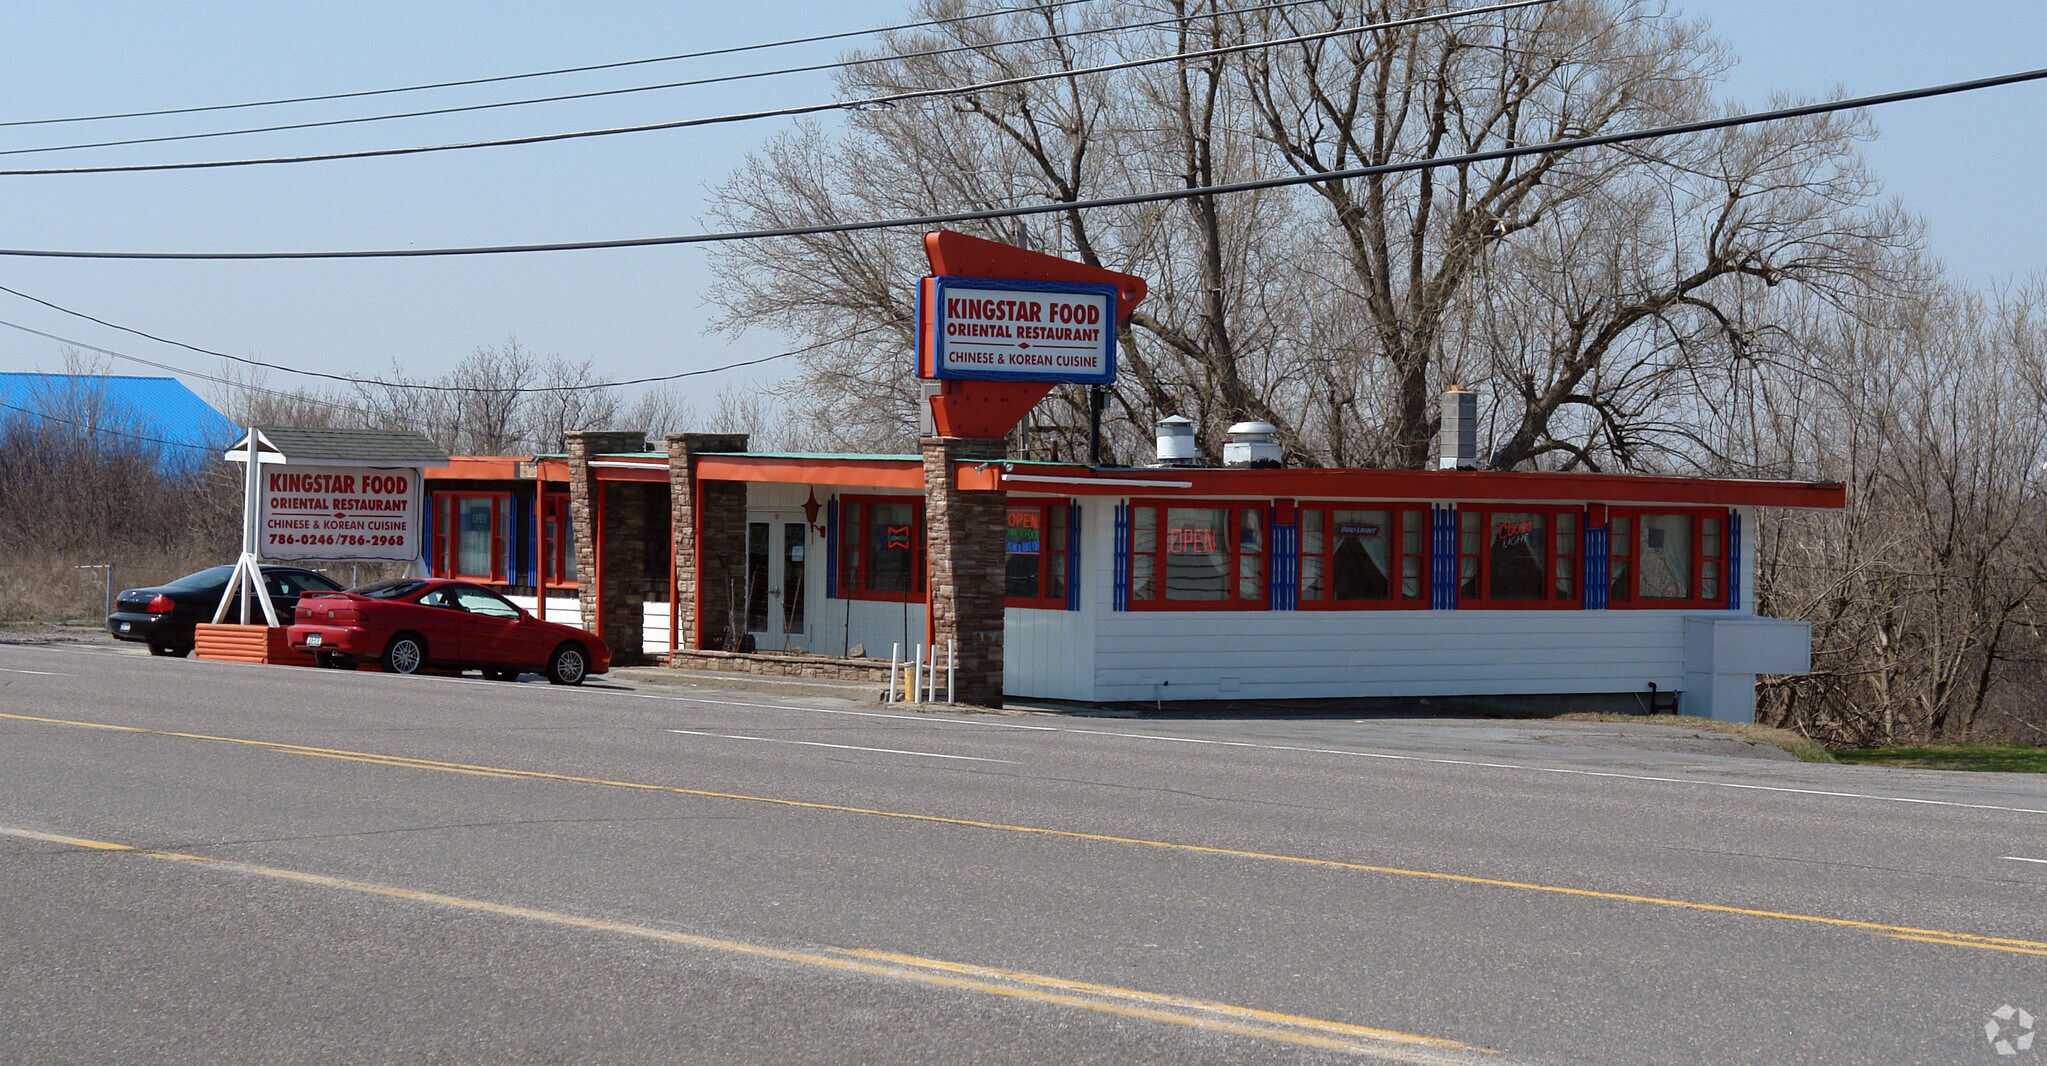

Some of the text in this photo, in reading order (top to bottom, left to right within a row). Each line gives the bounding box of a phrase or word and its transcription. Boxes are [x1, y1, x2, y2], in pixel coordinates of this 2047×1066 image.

[947, 297, 1100, 325] KINGSTAR FOOD
[946, 322, 1100, 342] ORIENTAL RESTAURANT
[949, 351, 1098, 368] CHINESE & KOREAN CUISINE
[269, 472, 408, 495] KINGSTAR FOOD
[270, 497, 408, 512] ORIENTAL RESTAURANT
[267, 519, 407, 531] CHINESE & KOREAN CUISINE
[1007, 511, 1039, 529] OPEN
[269, 533, 405, 546] 786-0246/786-2968
[1170, 528, 1217, 553] OPEN
